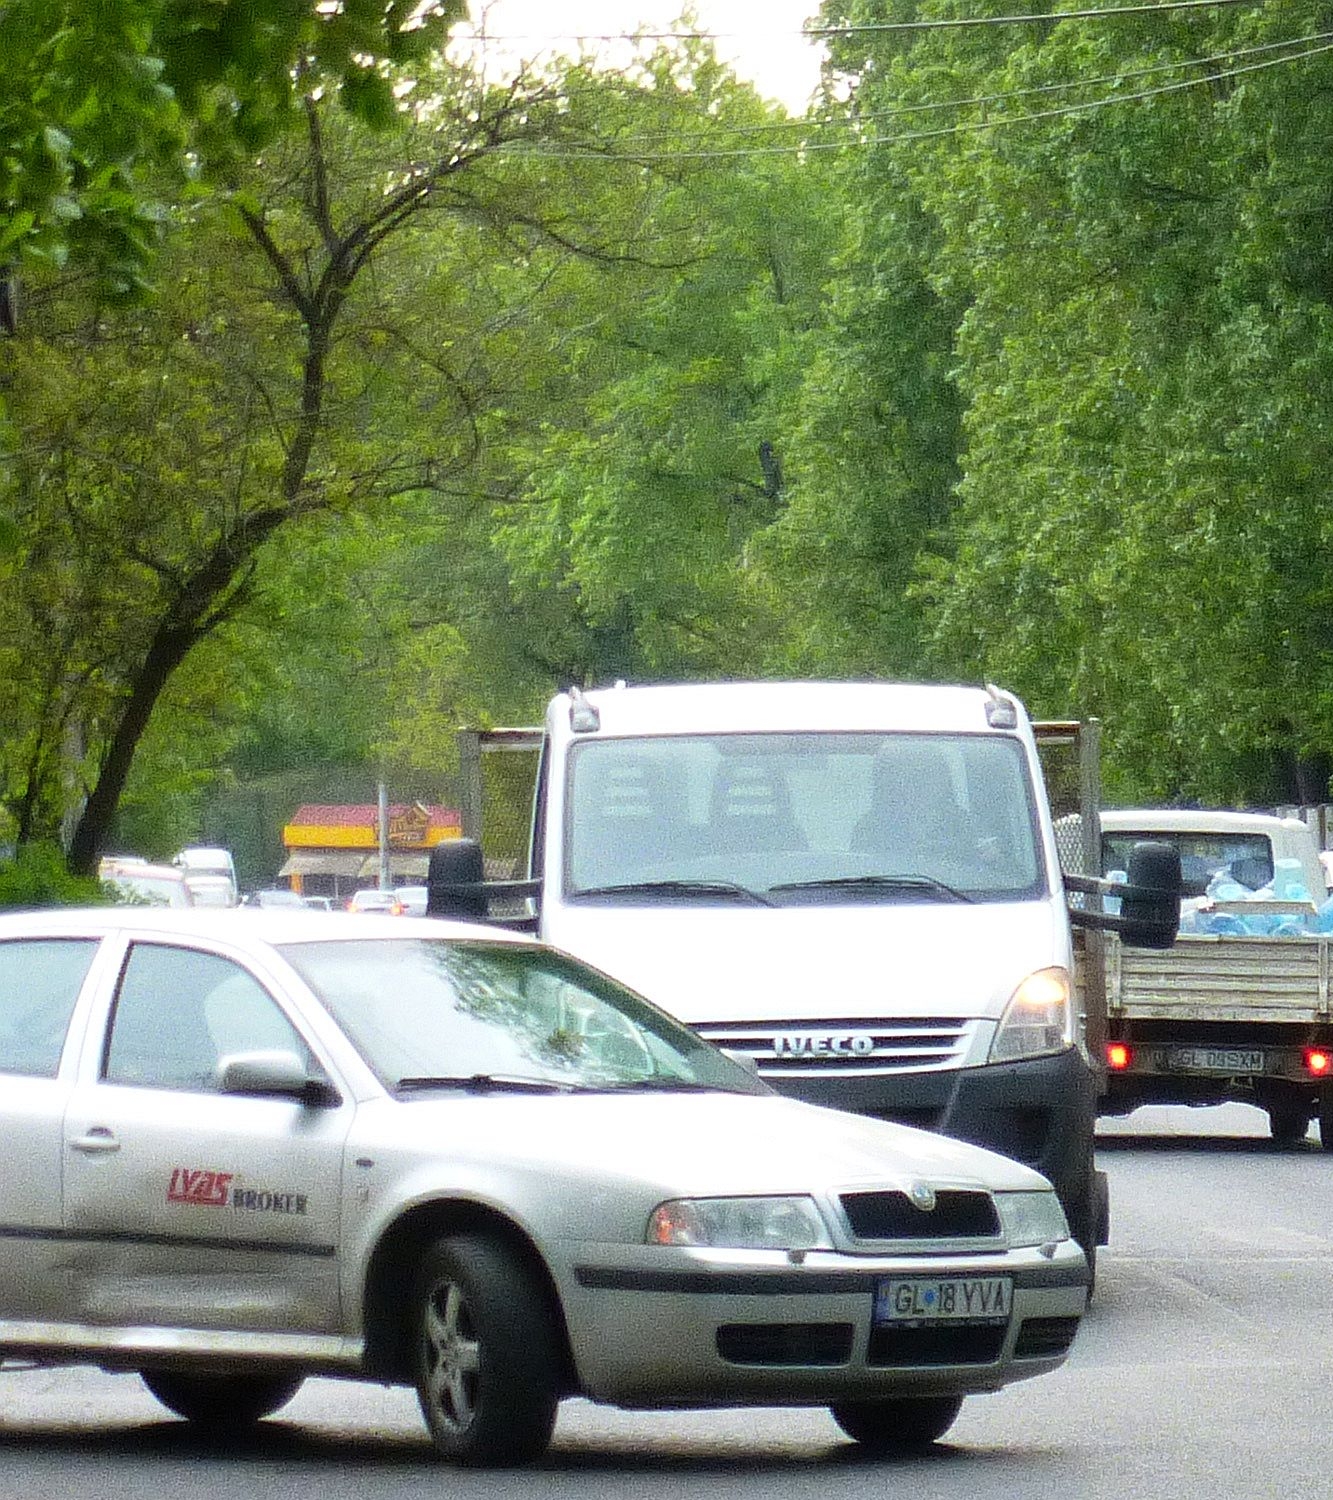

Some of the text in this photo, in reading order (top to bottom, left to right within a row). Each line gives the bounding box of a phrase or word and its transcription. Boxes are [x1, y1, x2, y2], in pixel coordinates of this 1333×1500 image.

[774, 1036, 873, 1058] IVECO
[233, 1188, 309, 1215] BROKER
[895, 1280, 1005, 1315] GL 18 YVA
